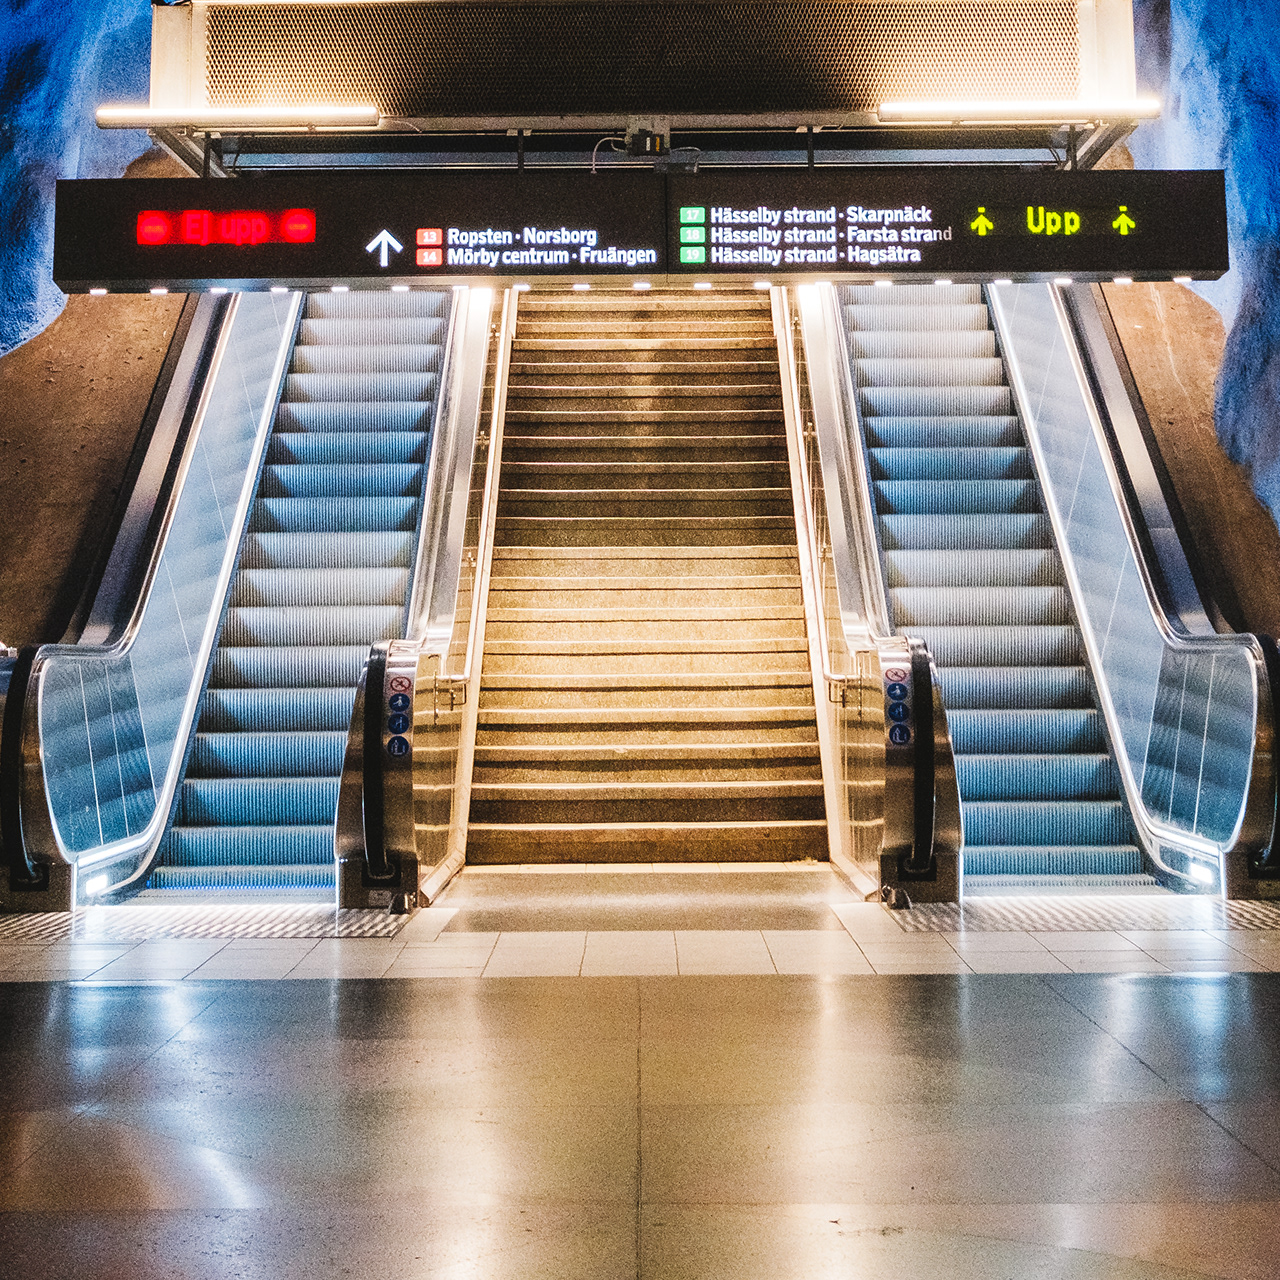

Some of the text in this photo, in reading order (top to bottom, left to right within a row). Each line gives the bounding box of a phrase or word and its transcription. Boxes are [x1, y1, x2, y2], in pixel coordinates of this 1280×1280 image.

[687, 206, 932, 224] 17 Hässelby strand Skarpnäck
[1027, 206, 1080, 235] Upp
[186, 213, 267, 246] Ej upp
[423, 227, 597, 246] 13 Ropsten Norsborg
[687, 226, 952, 245] 18 Hässelby strand Farsta strand
[423, 252, 437, 262] 14
[448, 248, 499, 267] Mörby
[502, 248, 569, 265] centrum
[686, 246, 921, 265] 19 Hässelby strand Hagsätra
